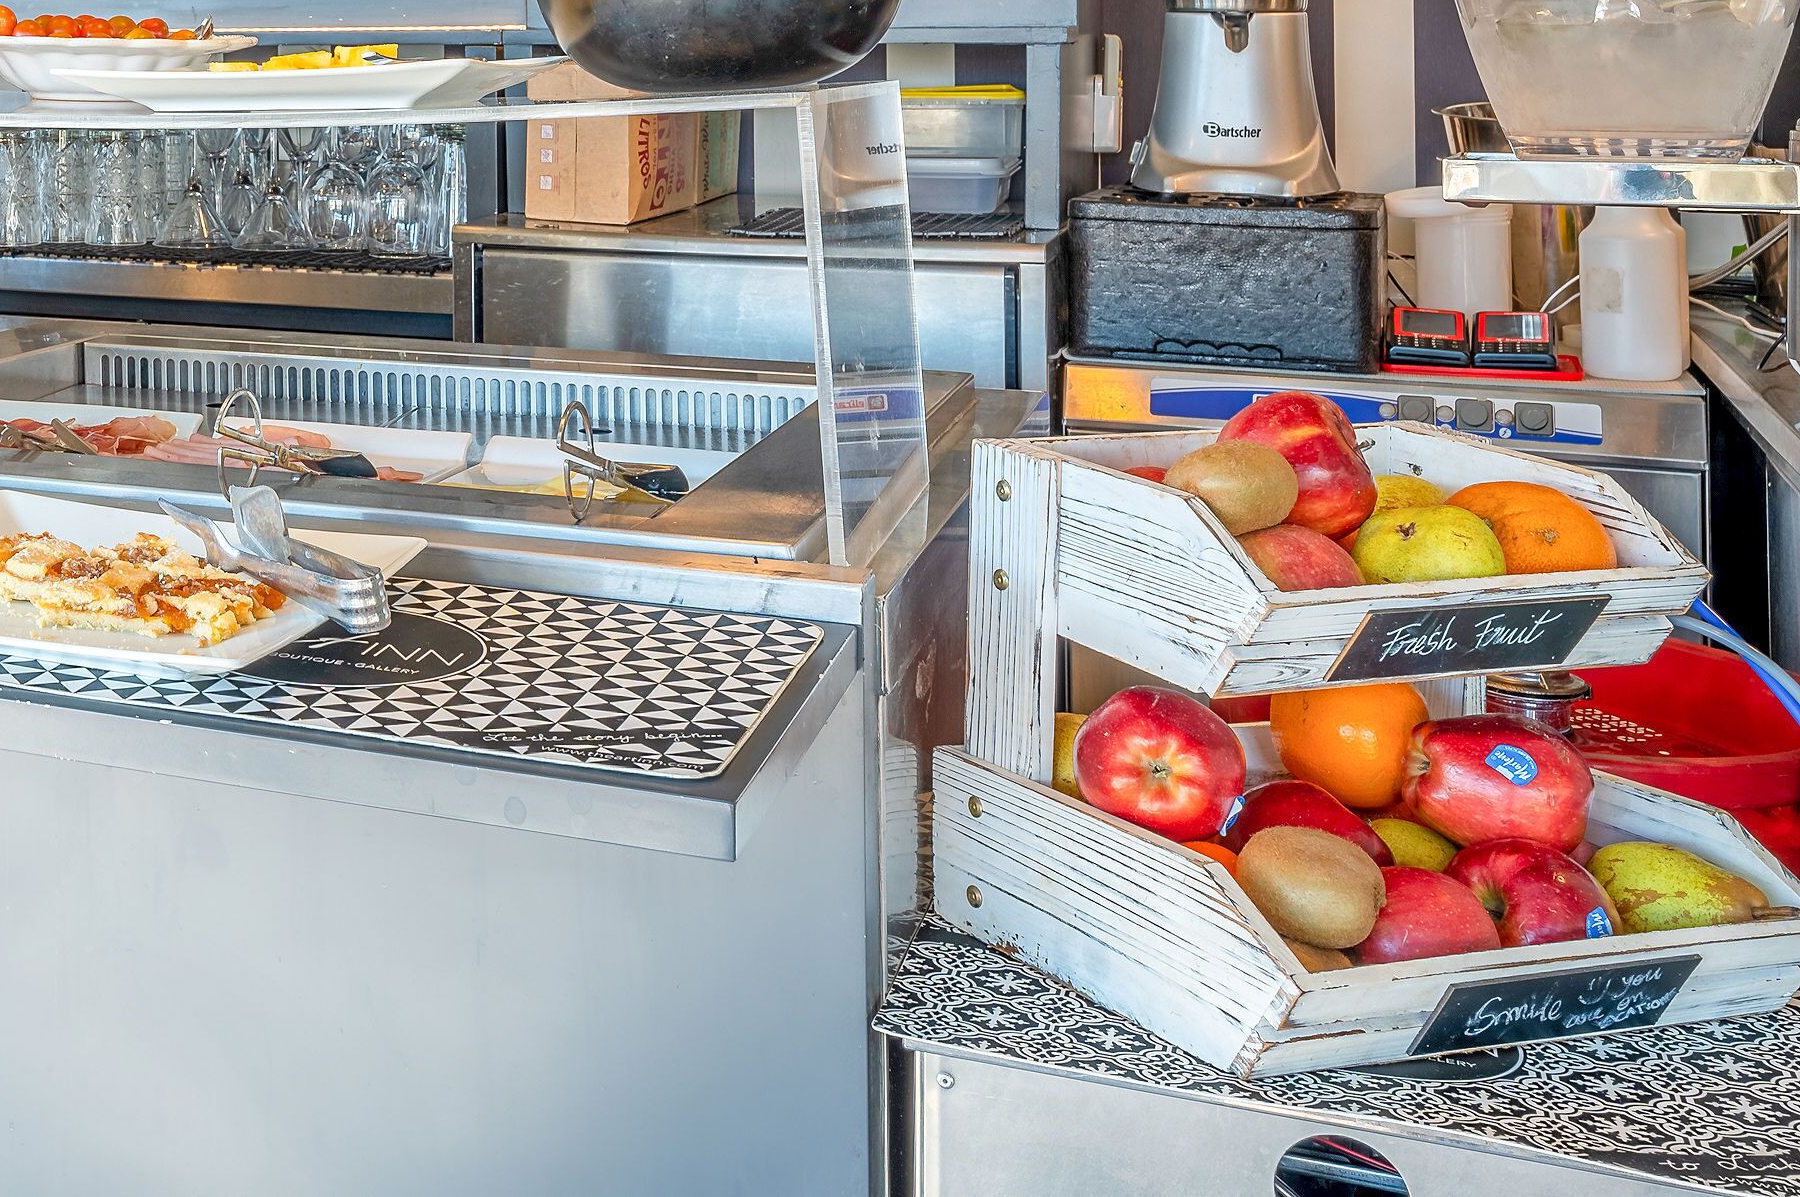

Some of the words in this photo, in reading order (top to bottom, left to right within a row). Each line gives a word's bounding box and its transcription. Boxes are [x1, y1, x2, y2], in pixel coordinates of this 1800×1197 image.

[1202, 121, 1262, 139] Bartscher
[638, 117, 652, 191] LITROS
[1379, 615, 1458, 663] Fresh
[1474, 609, 1564, 650] Fruit
[354, 661, 421, 675] GALLERY
[526, 732, 564, 742] the
[573, 733, 635, 743] story
[1494, 750, 1532, 781] Marlene
[1463, 996, 1563, 1037] Smile
[1658, 1159, 1701, 1170] to
